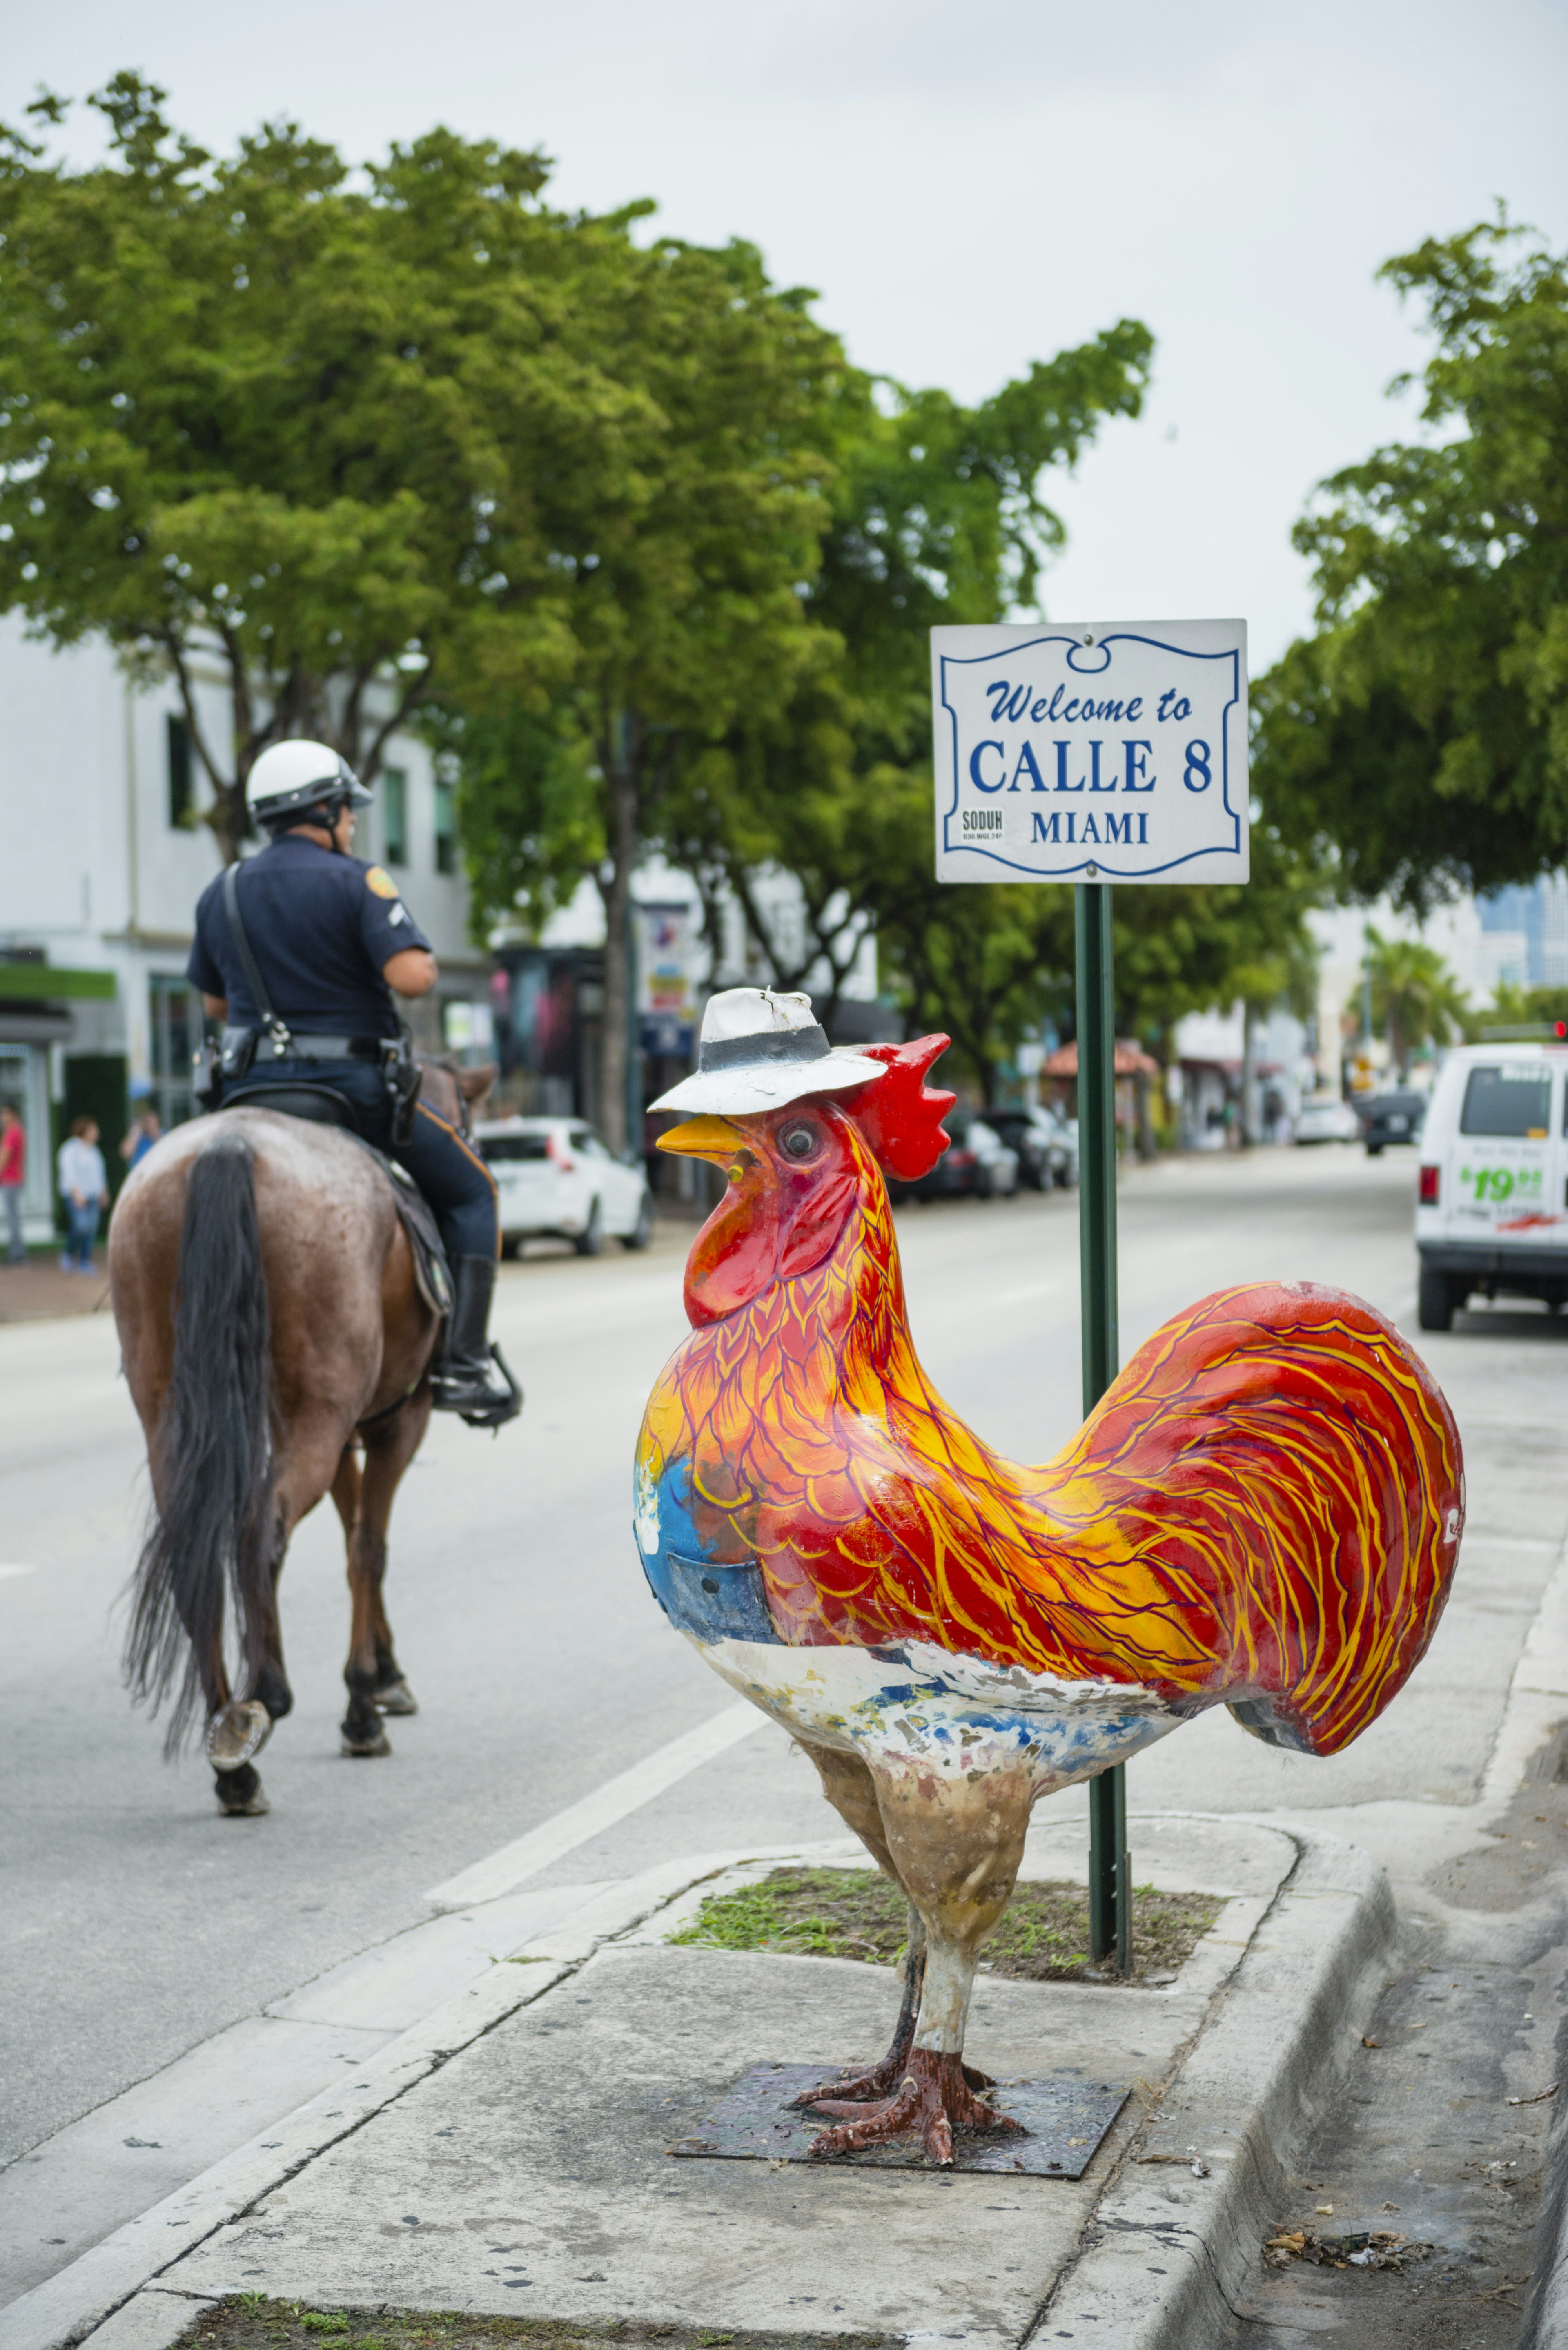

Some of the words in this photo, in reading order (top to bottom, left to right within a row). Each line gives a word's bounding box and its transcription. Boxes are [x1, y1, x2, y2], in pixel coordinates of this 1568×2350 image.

[986, 680, 1143, 722] Welcome
[1157, 688, 1192, 722] to
[969, 740, 1157, 793] CALLE
[1183, 739, 1212, 792] 8
[963, 810, 1002, 830] SODUH
[1031, 812, 1149, 844] MIAMI
